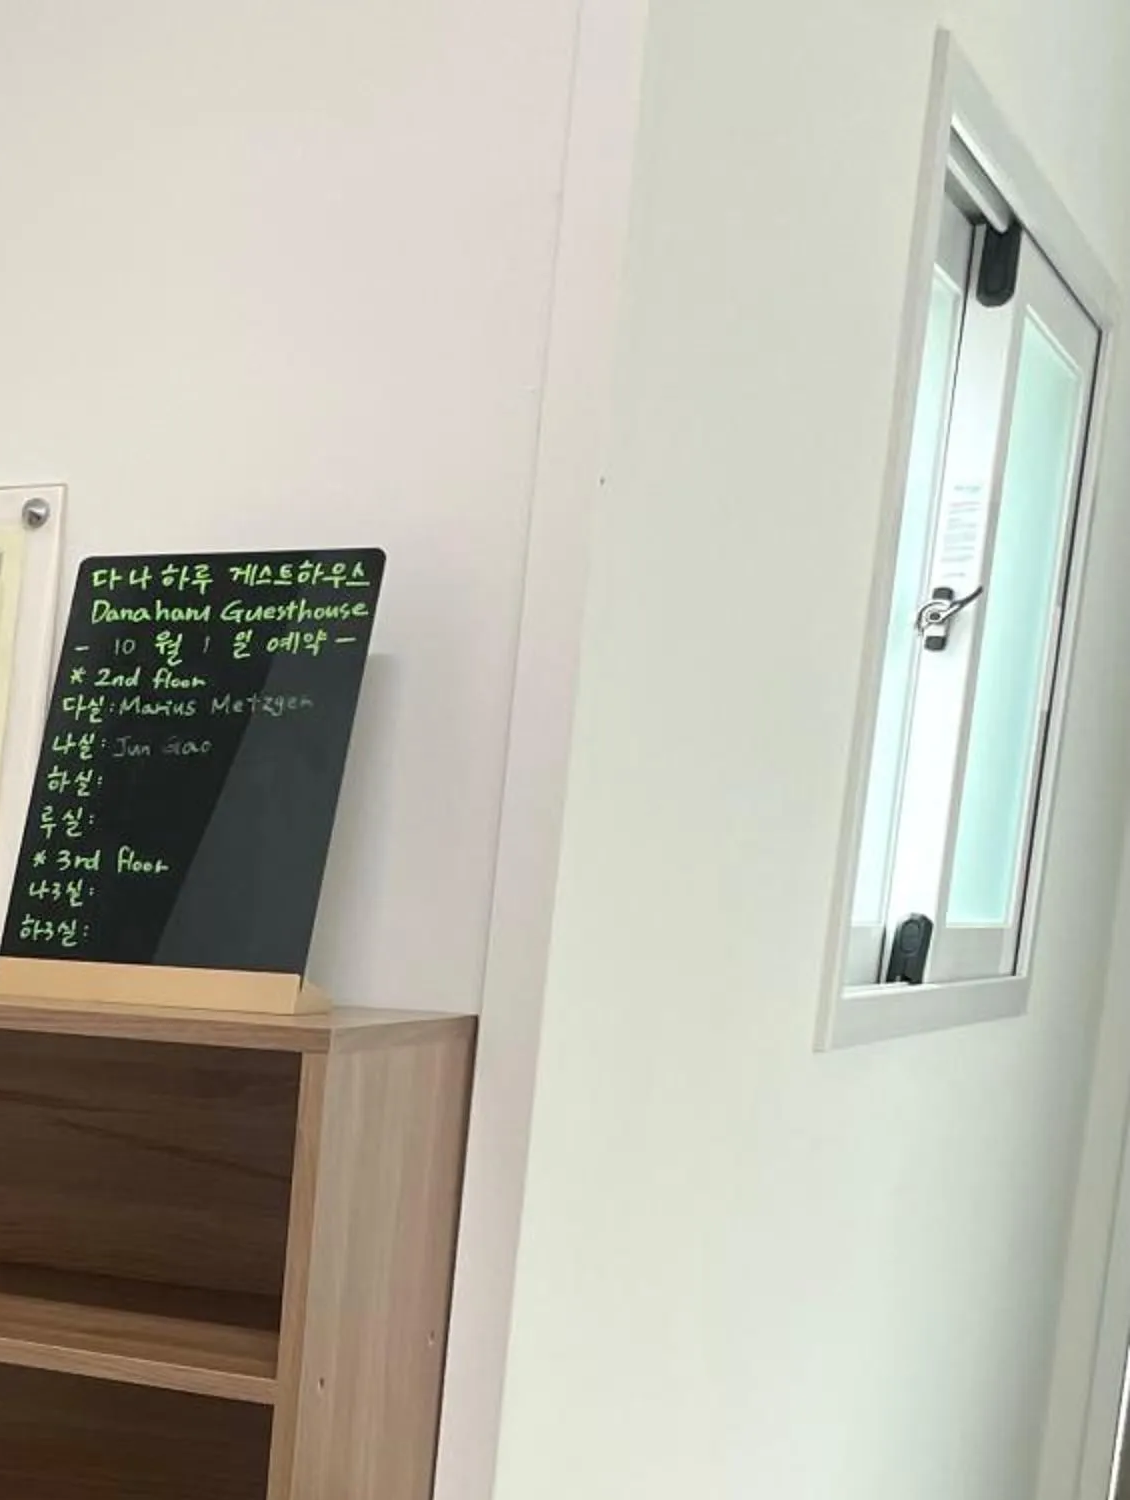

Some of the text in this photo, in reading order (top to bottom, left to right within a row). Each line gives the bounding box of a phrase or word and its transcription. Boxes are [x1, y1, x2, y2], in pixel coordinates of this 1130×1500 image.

[92, 560, 370, 595] 다나하루 게스트하우스
[92, 598, 368, 623] Danaharu Guesthouse
[115, 639, 136, 655] 10
[233, 629, 252, 659] 일
[267, 630, 327, 655] 예약
[94, 667, 207, 689] 2nd floor
[120, 698, 196, 716] Marius
[57, 845, 169, 873] 3rd floor
